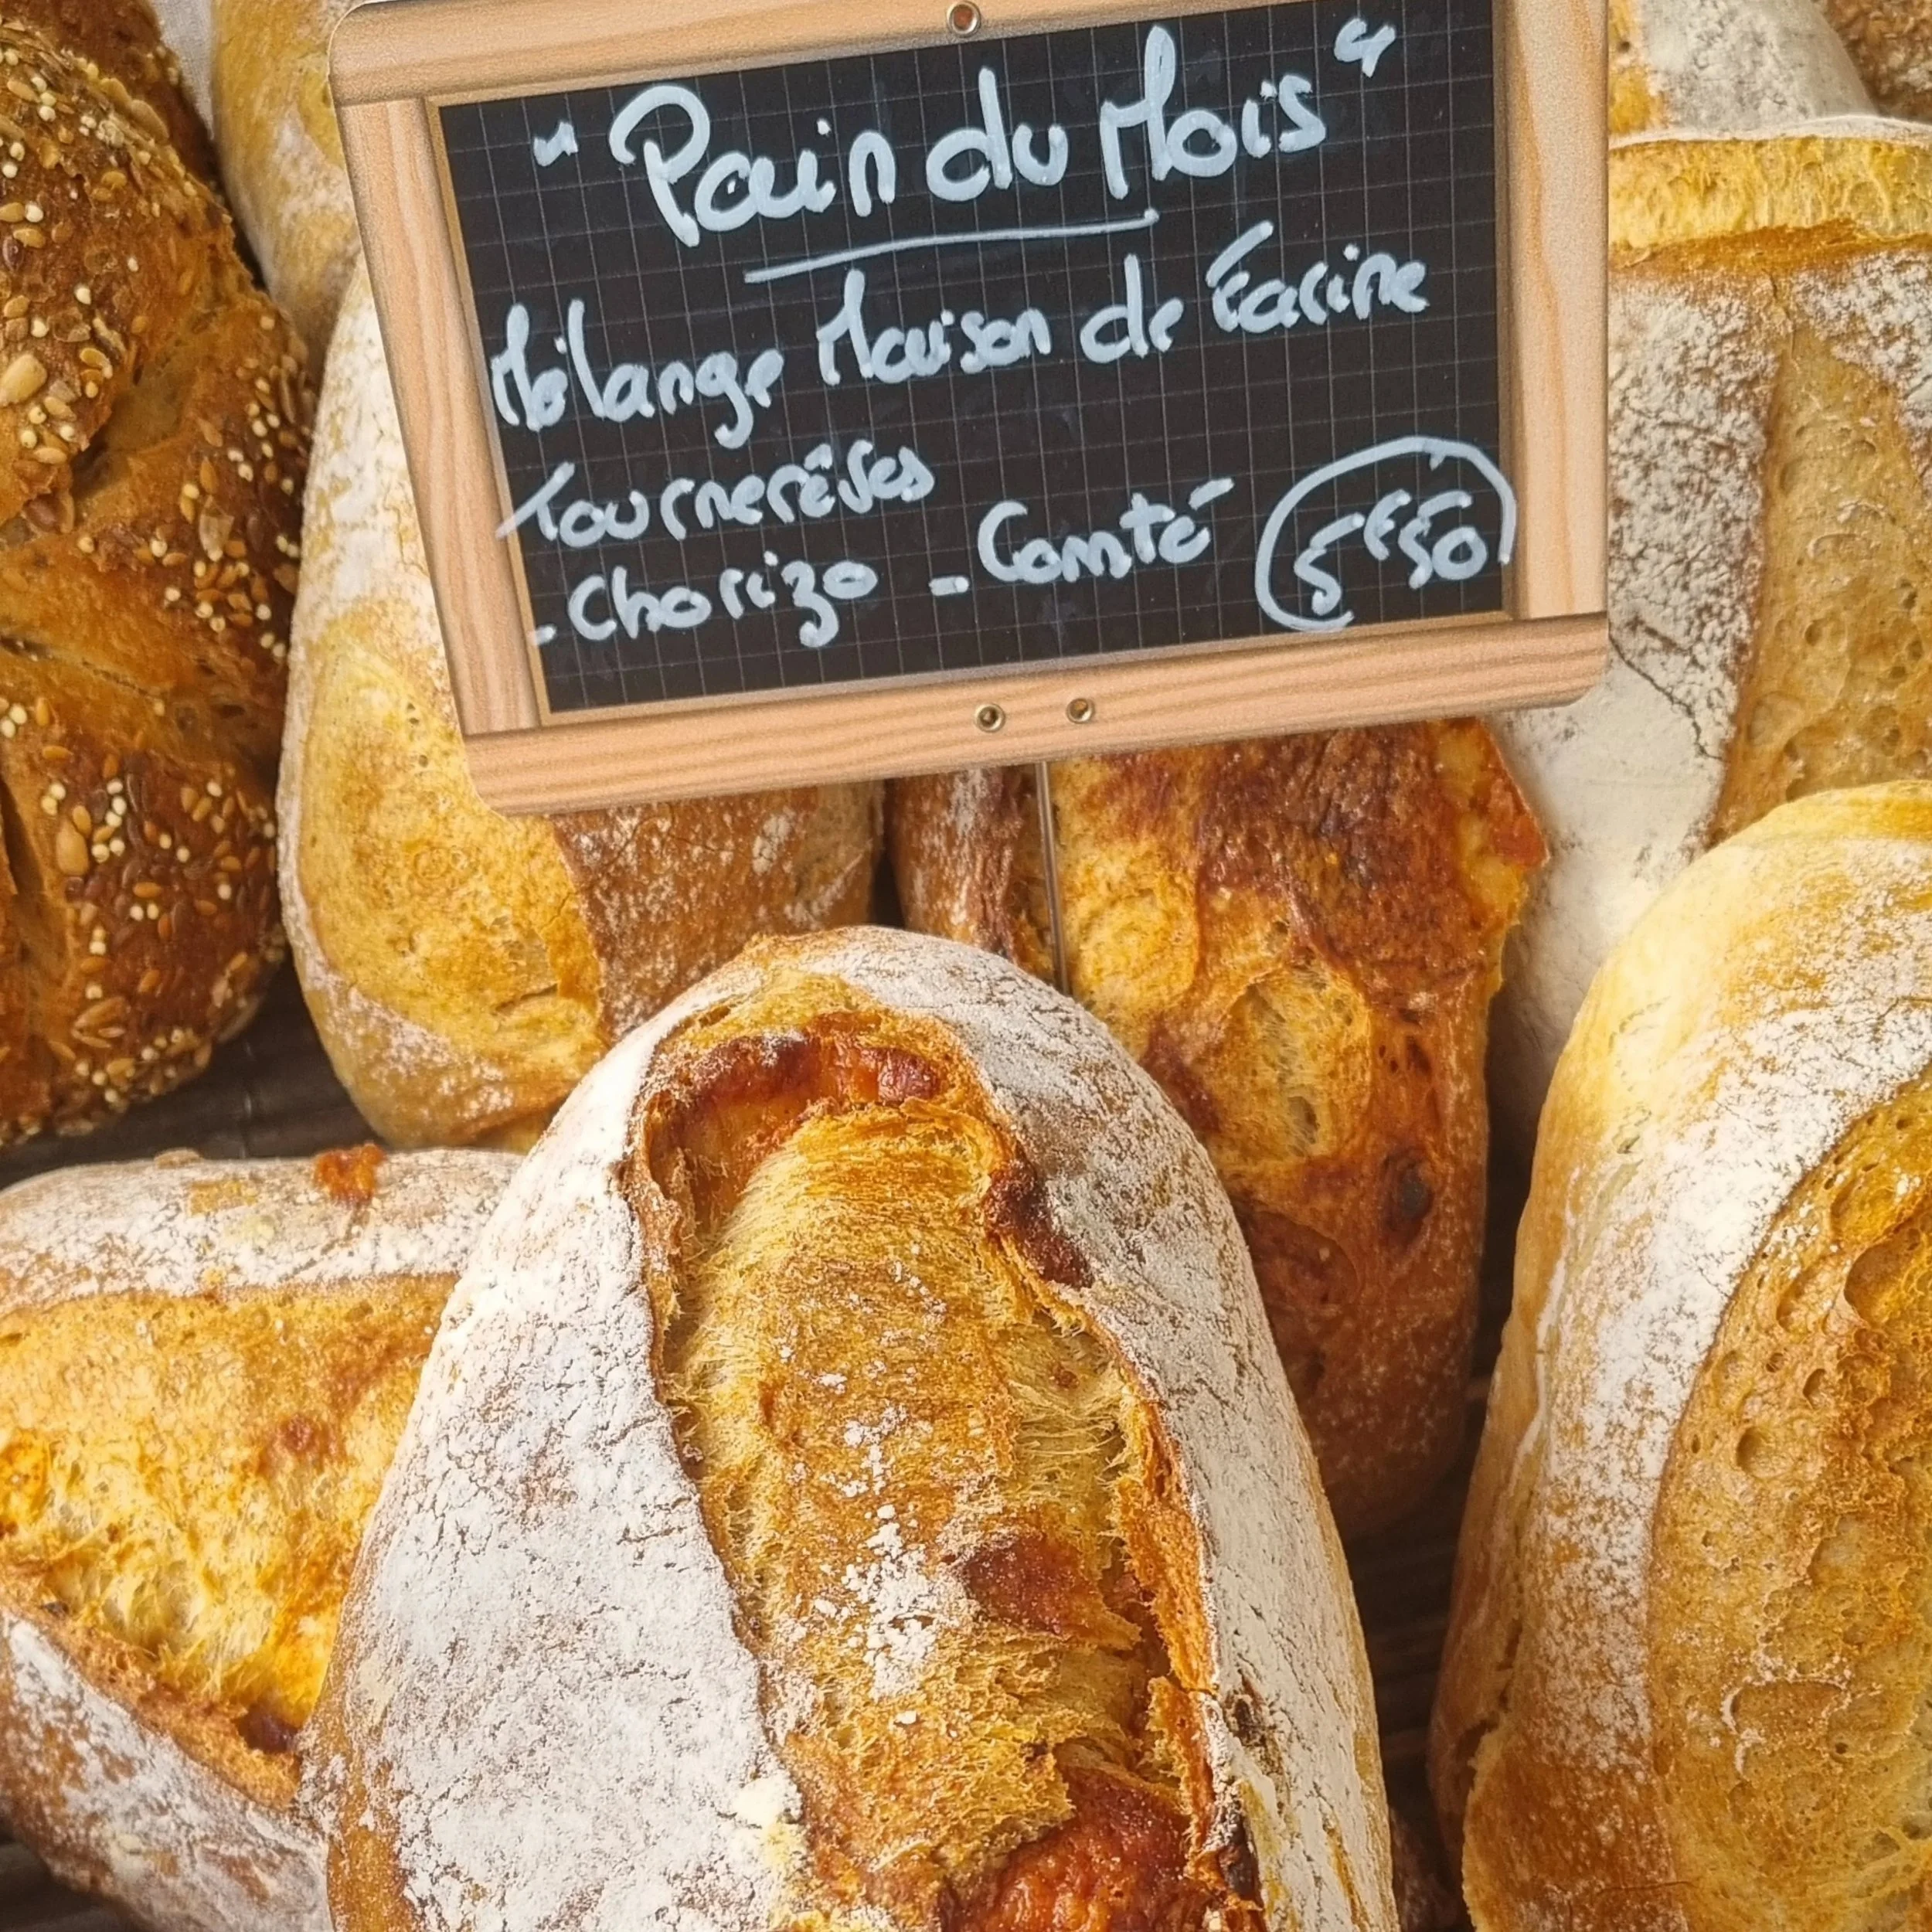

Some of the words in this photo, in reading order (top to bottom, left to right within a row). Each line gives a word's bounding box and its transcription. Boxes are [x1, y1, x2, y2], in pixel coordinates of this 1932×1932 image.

[608, 84, 896, 247] Pain
[925, 67, 1069, 202] du
[1099, 24, 1326, 199] Mois
[490, 299, 784, 449] Mélange
[815, 268, 1052, 386] Maison
[1080, 253, 1184, 363] de
[1205, 220, 1430, 333] Farine
